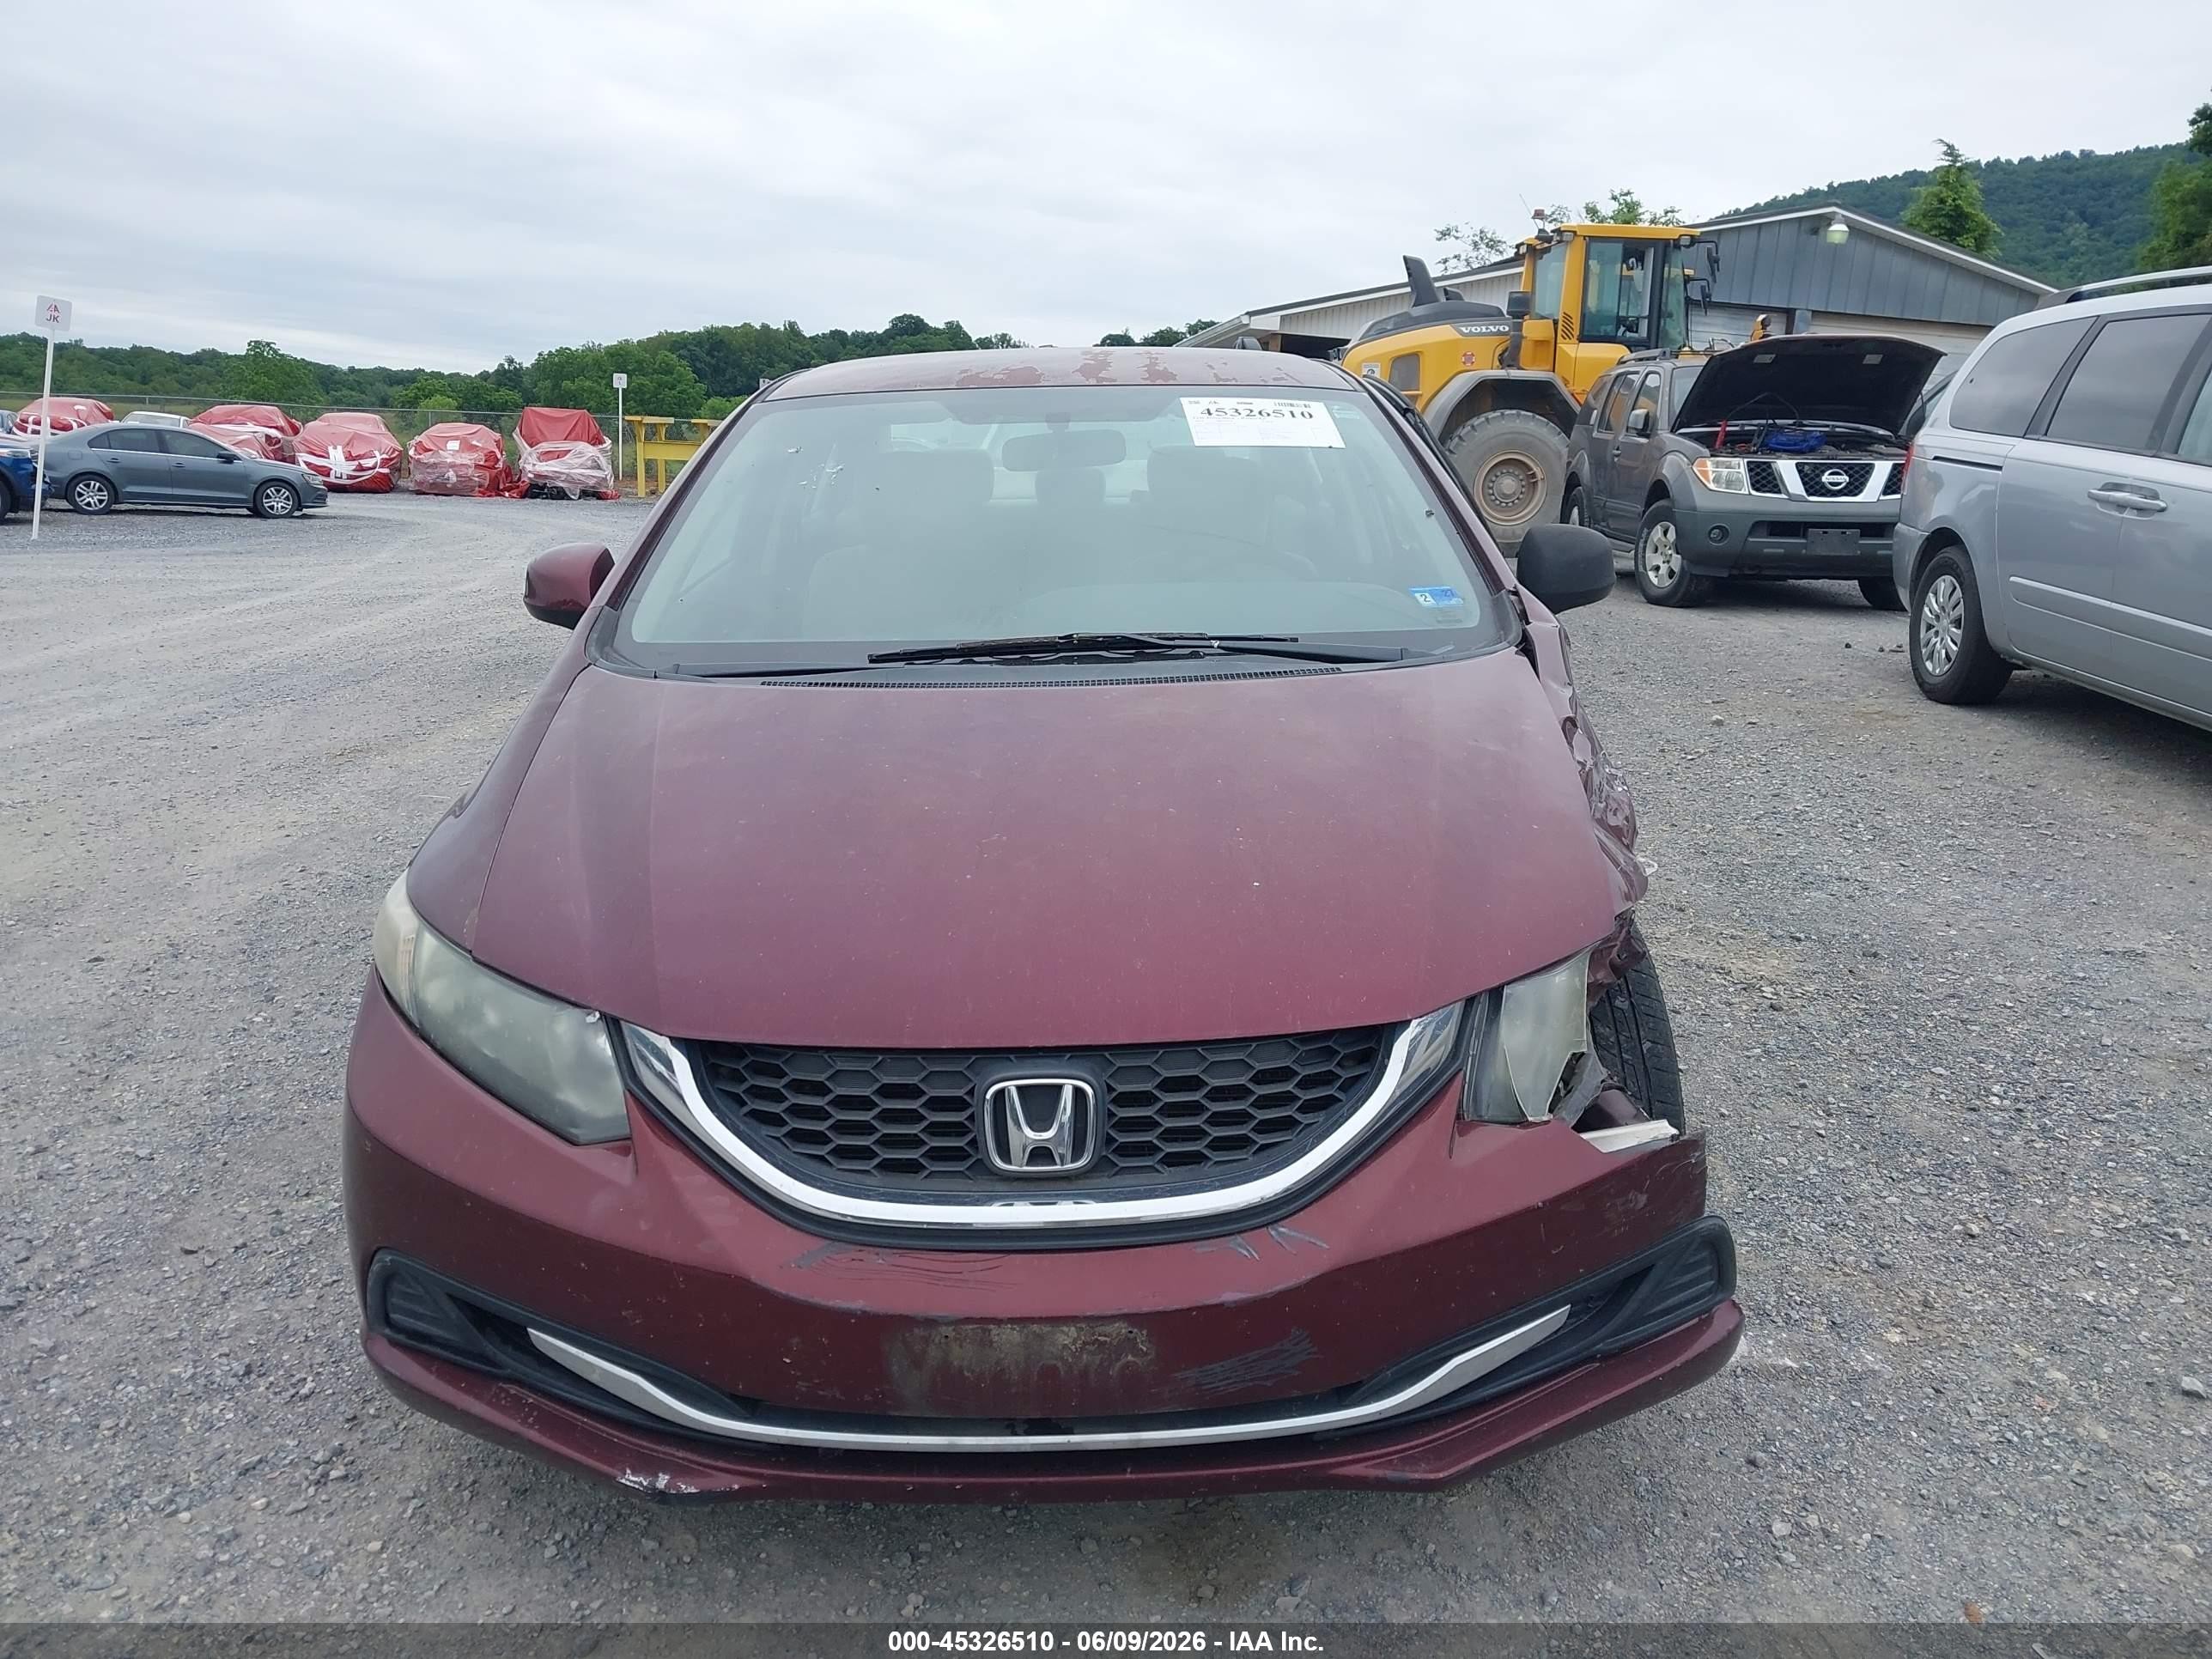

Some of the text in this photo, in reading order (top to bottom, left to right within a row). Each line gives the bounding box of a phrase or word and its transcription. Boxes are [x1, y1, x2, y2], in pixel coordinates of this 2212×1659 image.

[46, 313, 60, 324] JK
[1459, 325, 1510, 334] VOLVO
[1200, 407, 1314, 420] 45326510
